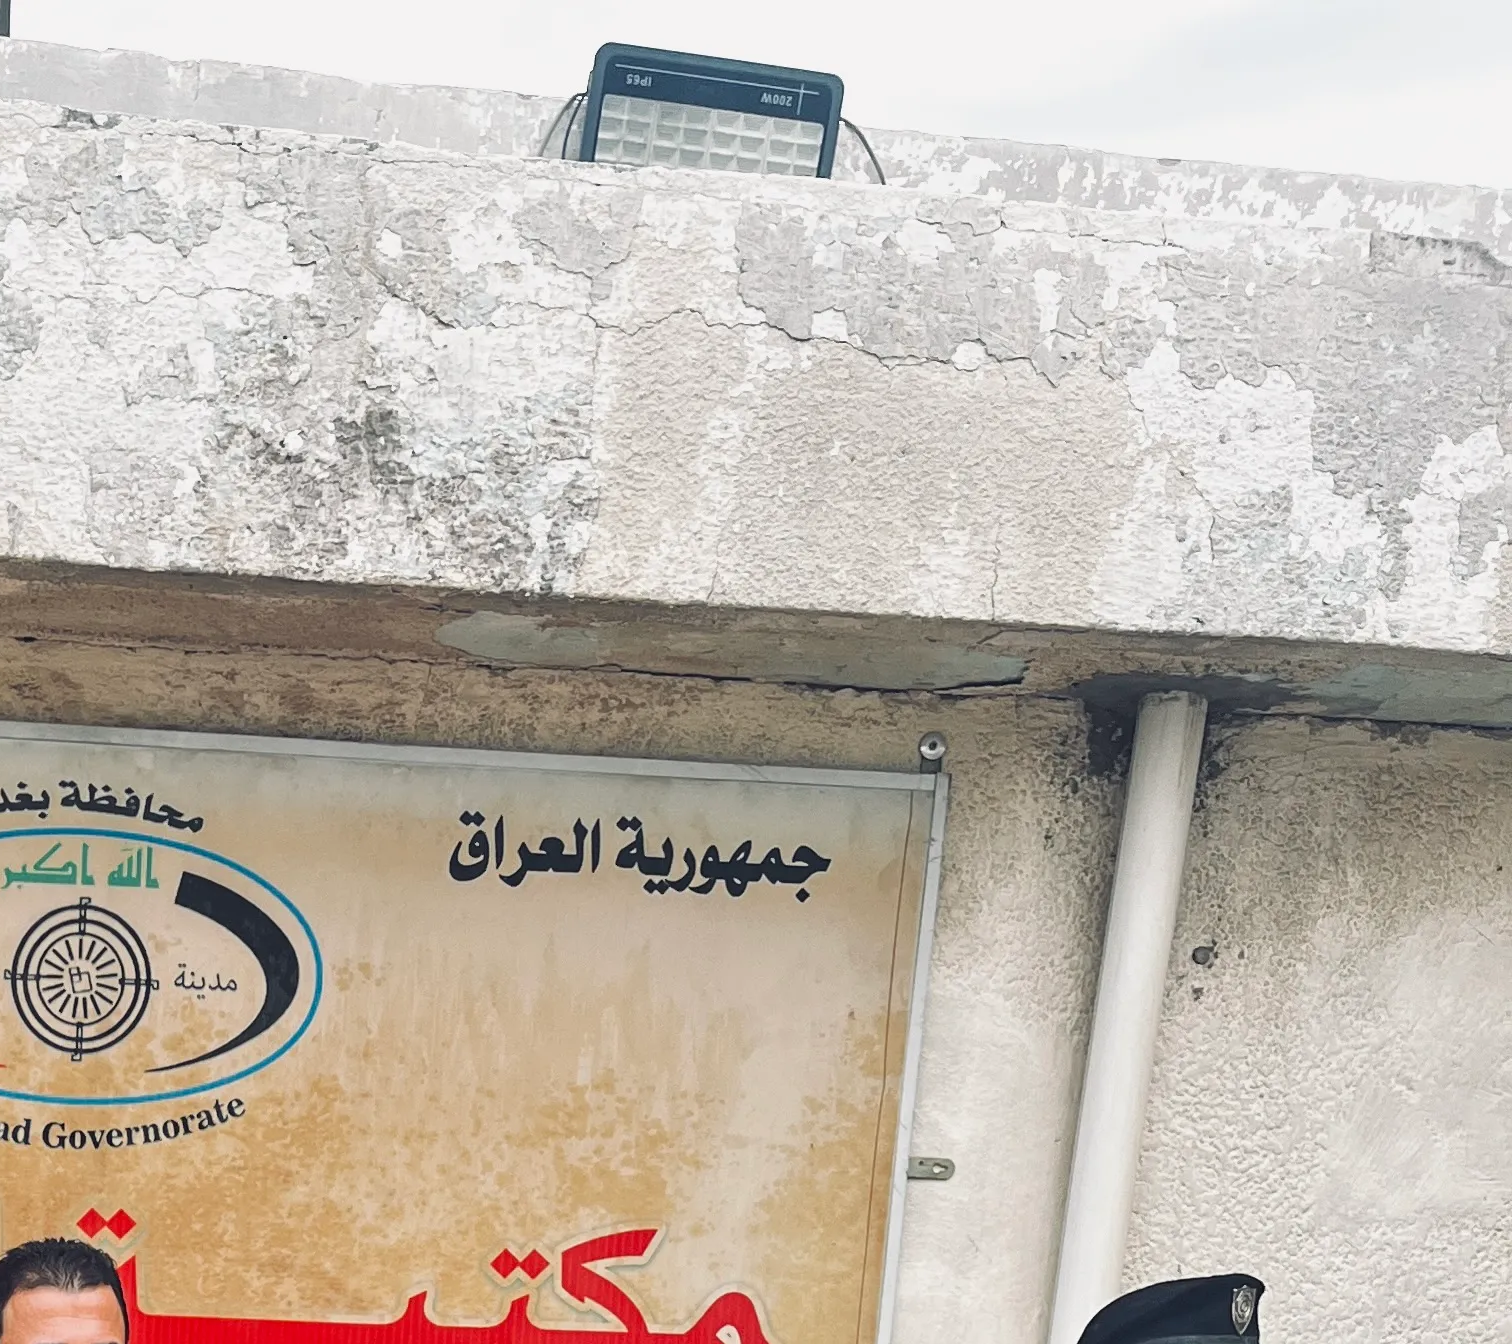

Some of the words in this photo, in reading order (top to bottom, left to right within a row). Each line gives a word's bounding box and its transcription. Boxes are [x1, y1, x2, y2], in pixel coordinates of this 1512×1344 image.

[625, 73, 653, 88] IP65
[760, 91, 793, 108] 200W
[59, 780, 205, 833] محافظة
[448, 810, 601, 886] العراق
[614, 815, 832, 904] جمهورية
[173, 962, 238, 1000] مدينة
[41, 1096, 247, 1151] Governorate
